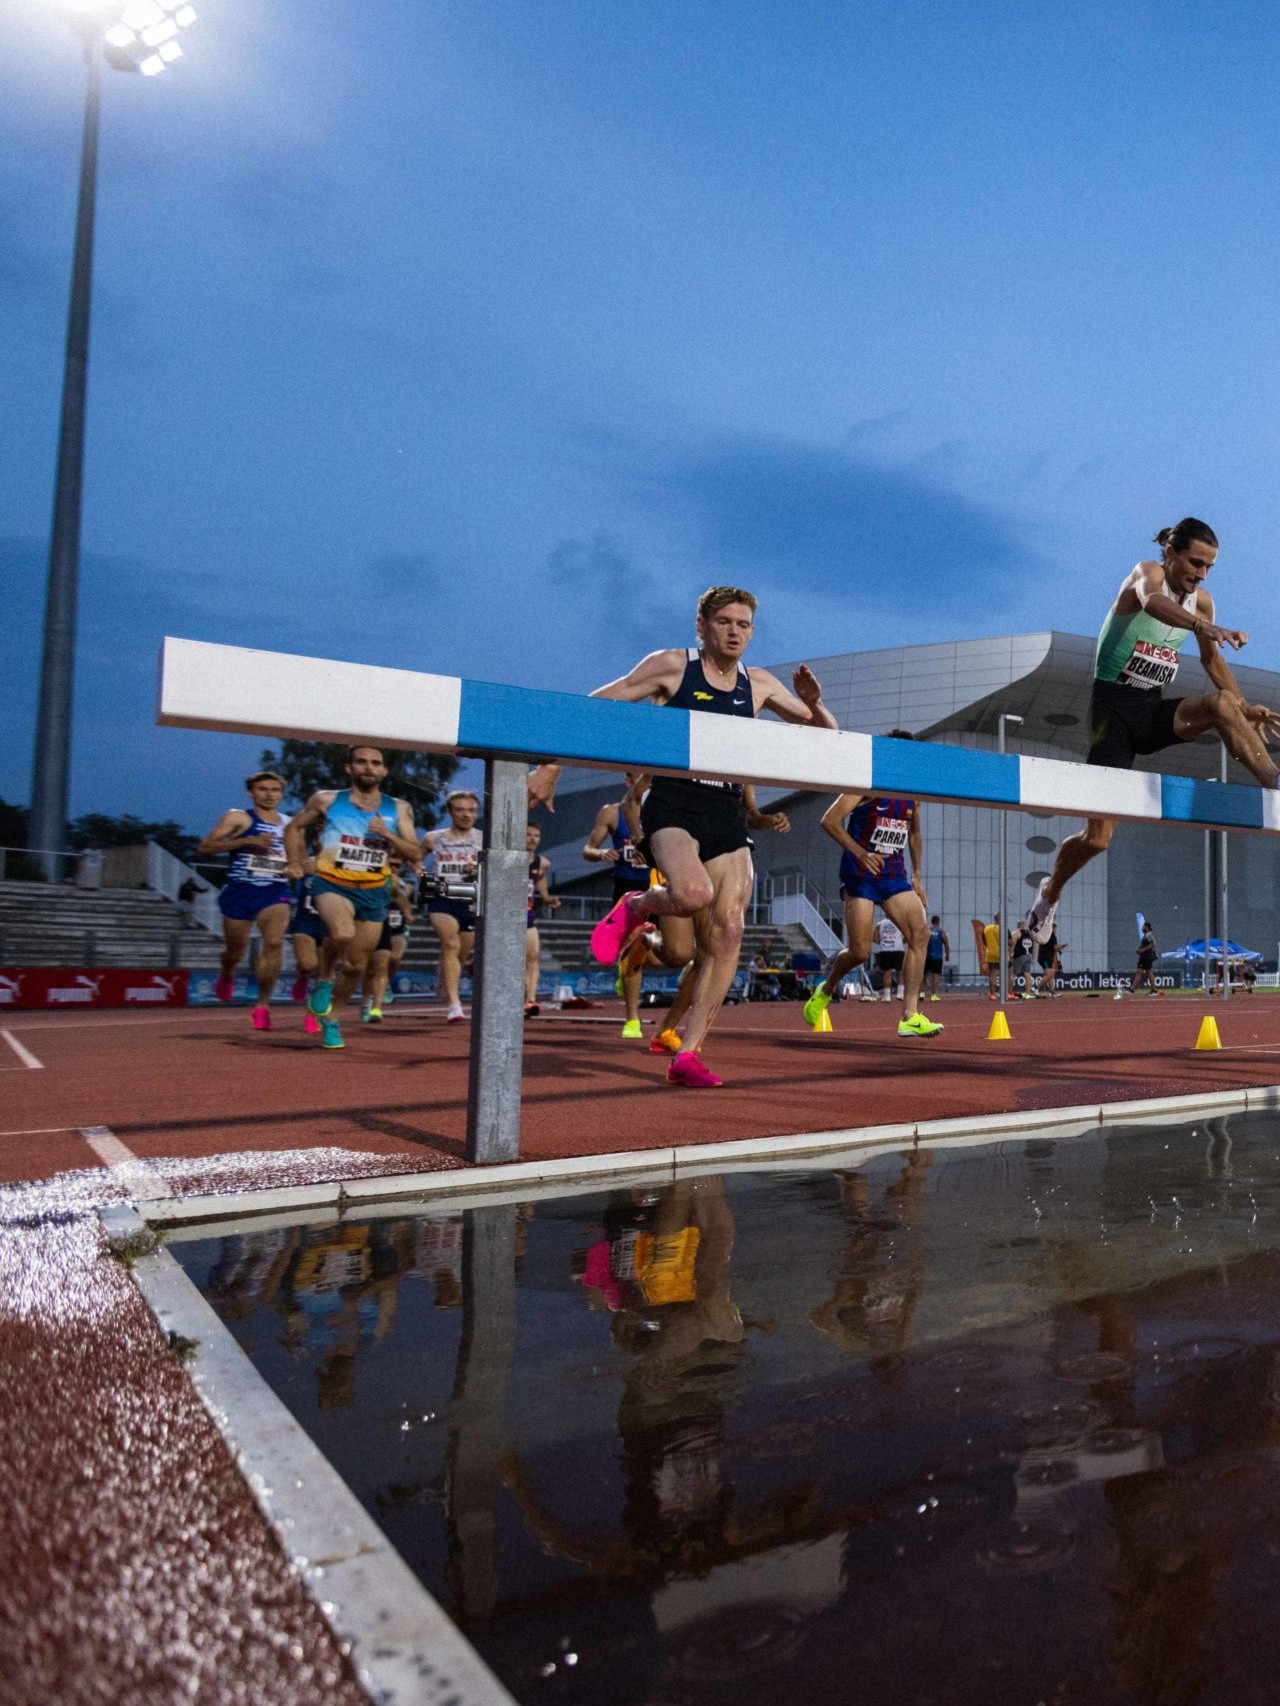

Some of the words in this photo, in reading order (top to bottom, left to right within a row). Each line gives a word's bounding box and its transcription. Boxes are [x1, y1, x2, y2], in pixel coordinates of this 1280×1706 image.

[1142, 642, 1177, 663] INEOS
[1126, 655, 1176, 684] BEAMISH
[881, 816, 908, 830] INEOS
[874, 829, 907, 846] PARRA
[340, 846, 385, 865] MARTOS
